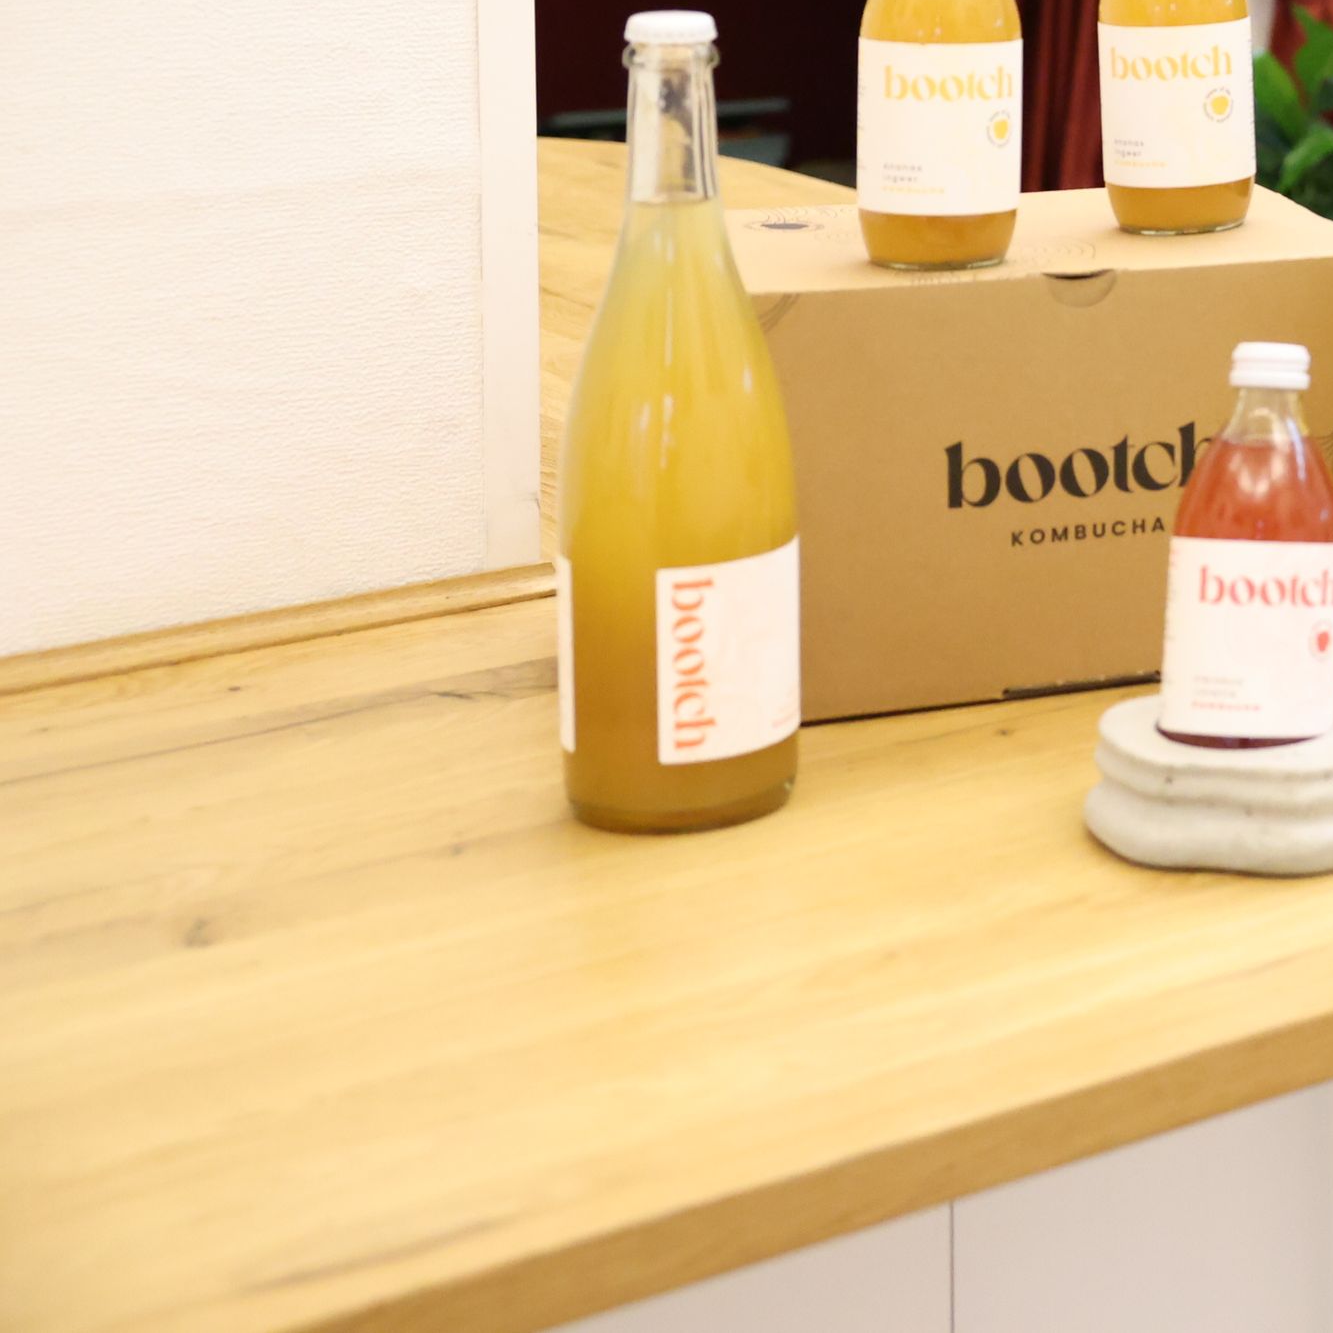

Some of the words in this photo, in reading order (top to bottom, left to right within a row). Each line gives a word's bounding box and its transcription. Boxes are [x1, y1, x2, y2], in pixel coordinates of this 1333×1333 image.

[1111, 45, 1232, 82] bootch
[883, 65, 1012, 102] bootch
[1011, 517, 1165, 547] KOMBUCHA
[671, 577, 717, 751] bootch
